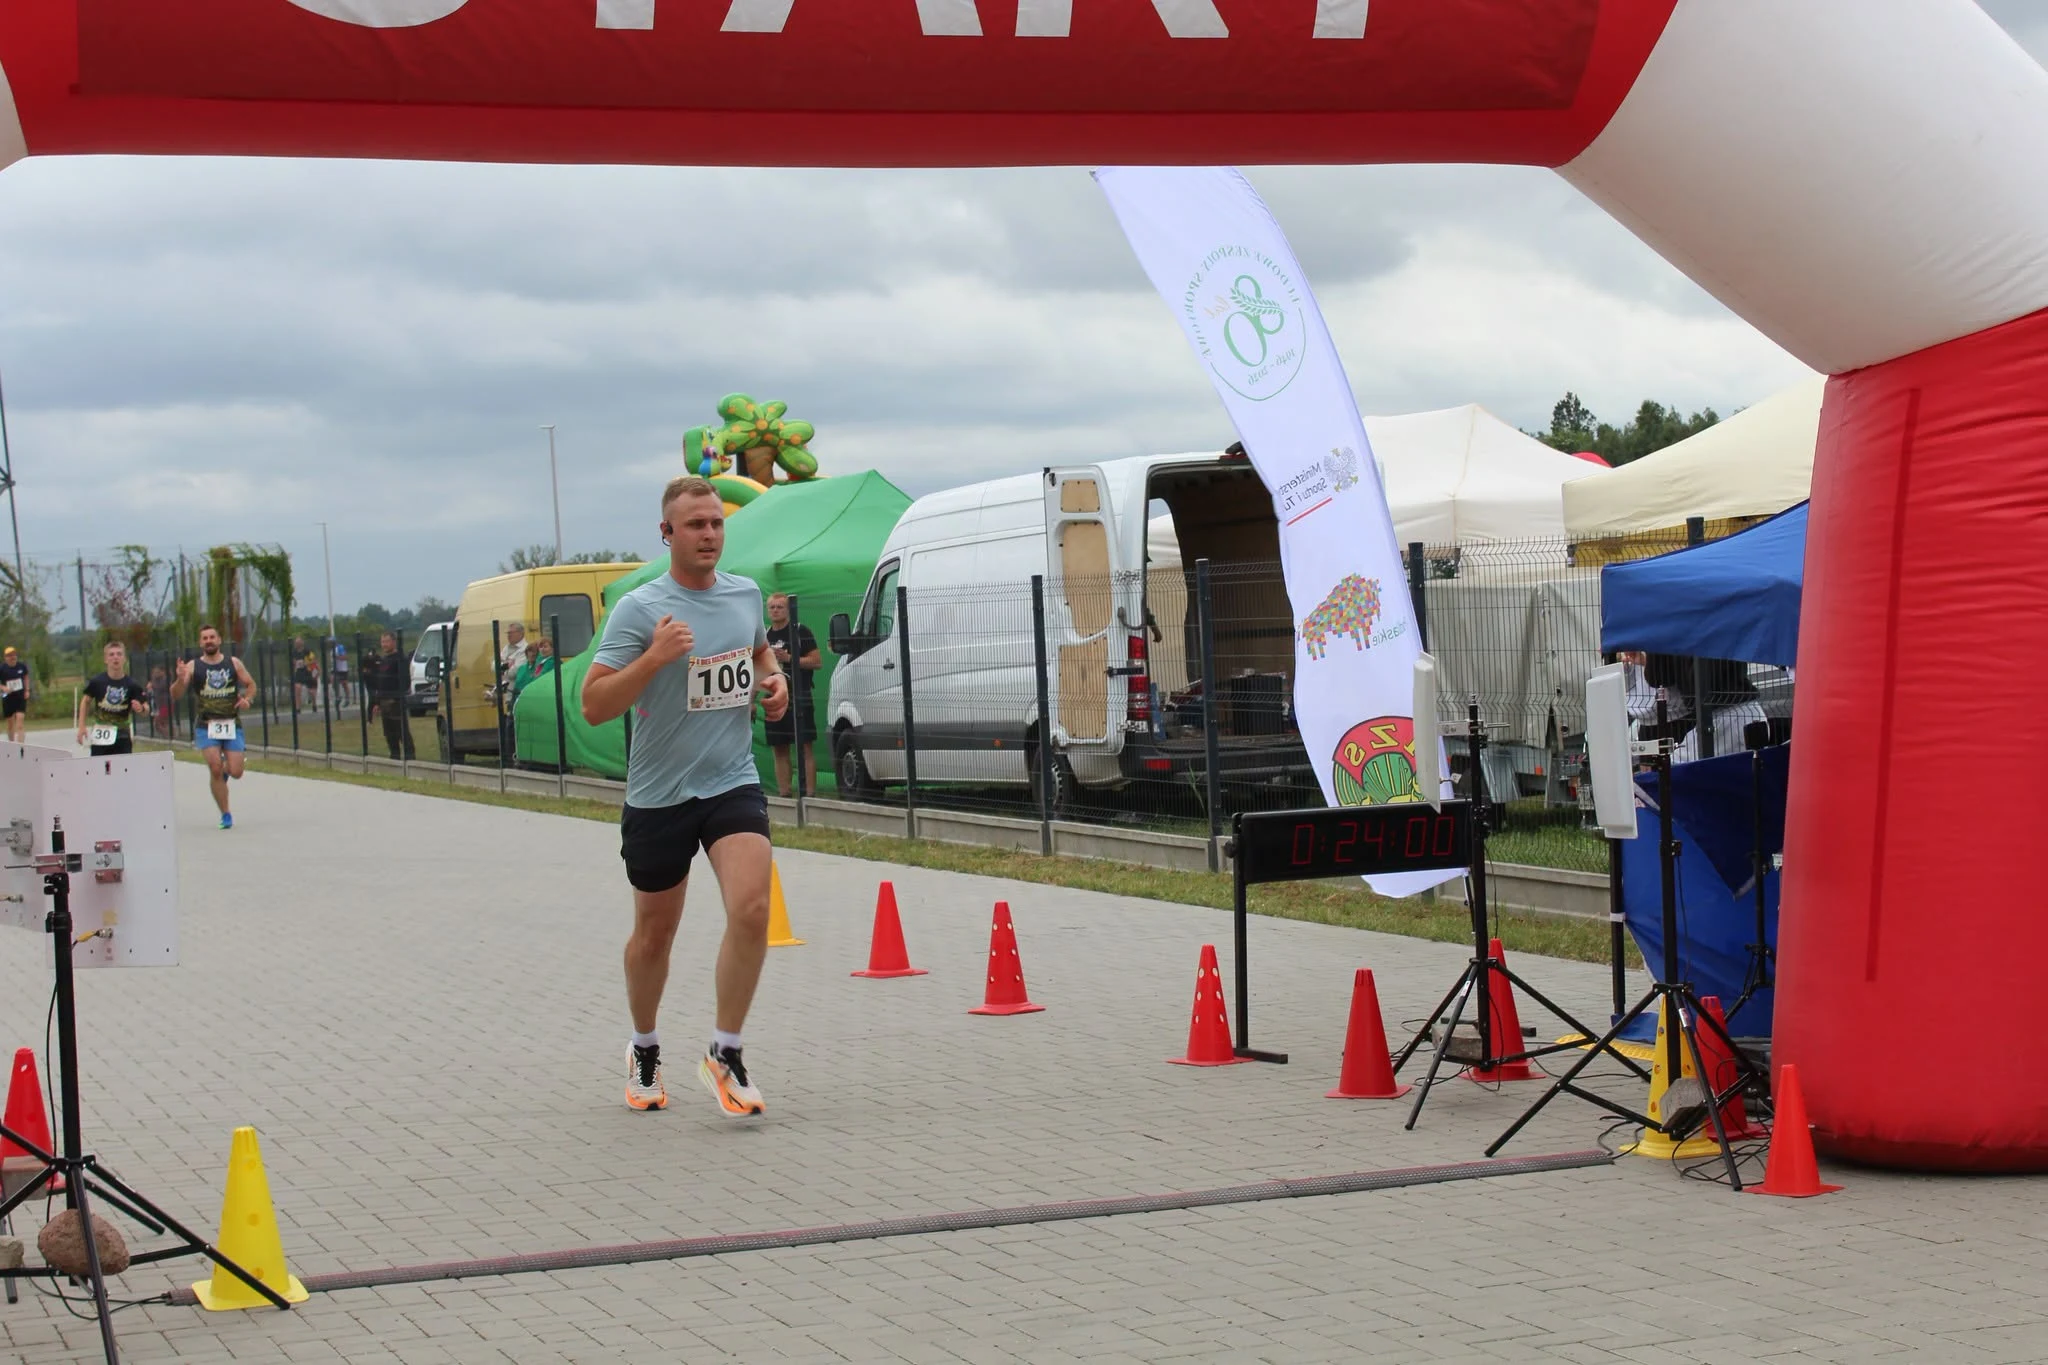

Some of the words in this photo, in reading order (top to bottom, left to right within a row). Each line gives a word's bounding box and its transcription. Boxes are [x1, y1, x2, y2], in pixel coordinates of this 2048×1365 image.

[697, 659, 751, 696] 106
[94, 729, 111, 741] 30
[215, 723, 231, 735] 31
[1291, 816, 1455, 866] 0:24:00
